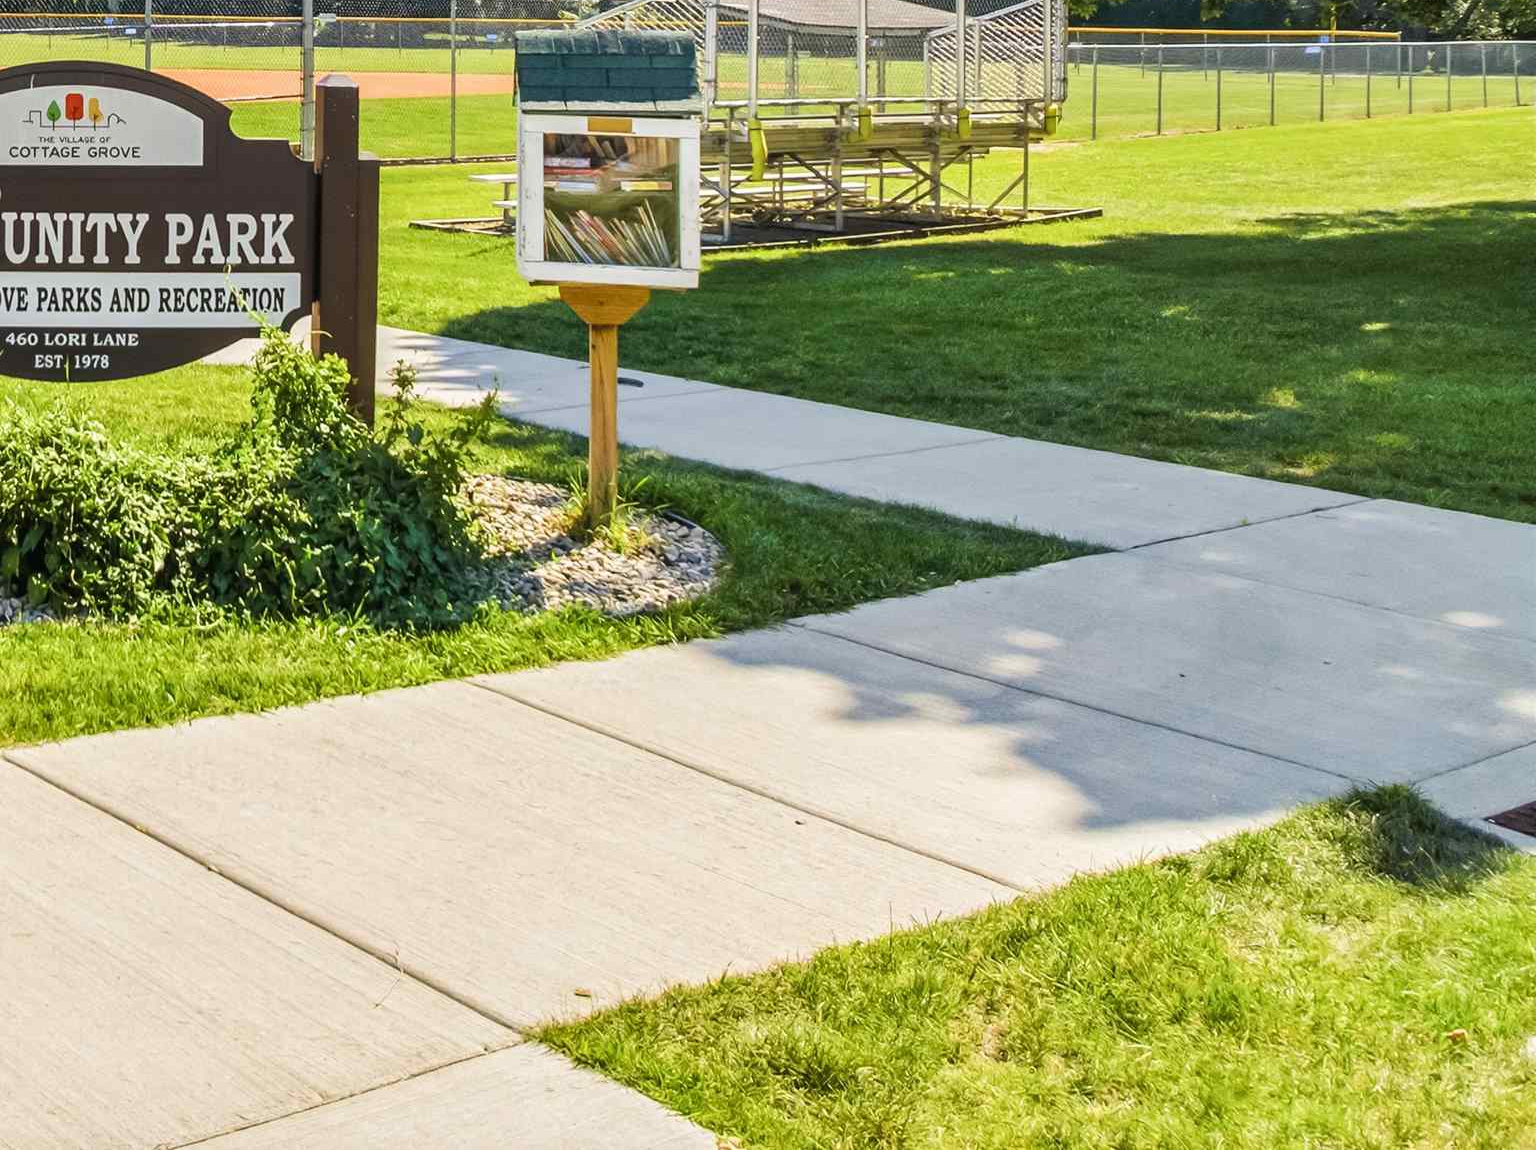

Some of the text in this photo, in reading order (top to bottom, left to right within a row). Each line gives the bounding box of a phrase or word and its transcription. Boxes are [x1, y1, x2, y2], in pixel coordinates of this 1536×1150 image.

[38, 135, 111, 144] THE VILLAGE OF
[8, 146, 141, 159] COTTAGE GROVE
[164, 213, 296, 266] PARK
[36, 286, 102, 313] PARKS
[109, 287, 150, 313] AND
[158, 287, 286, 314] RECREATION
[5, 332, 139, 347] 460 LORI LANE
[74, 354, 110, 369] 1978
